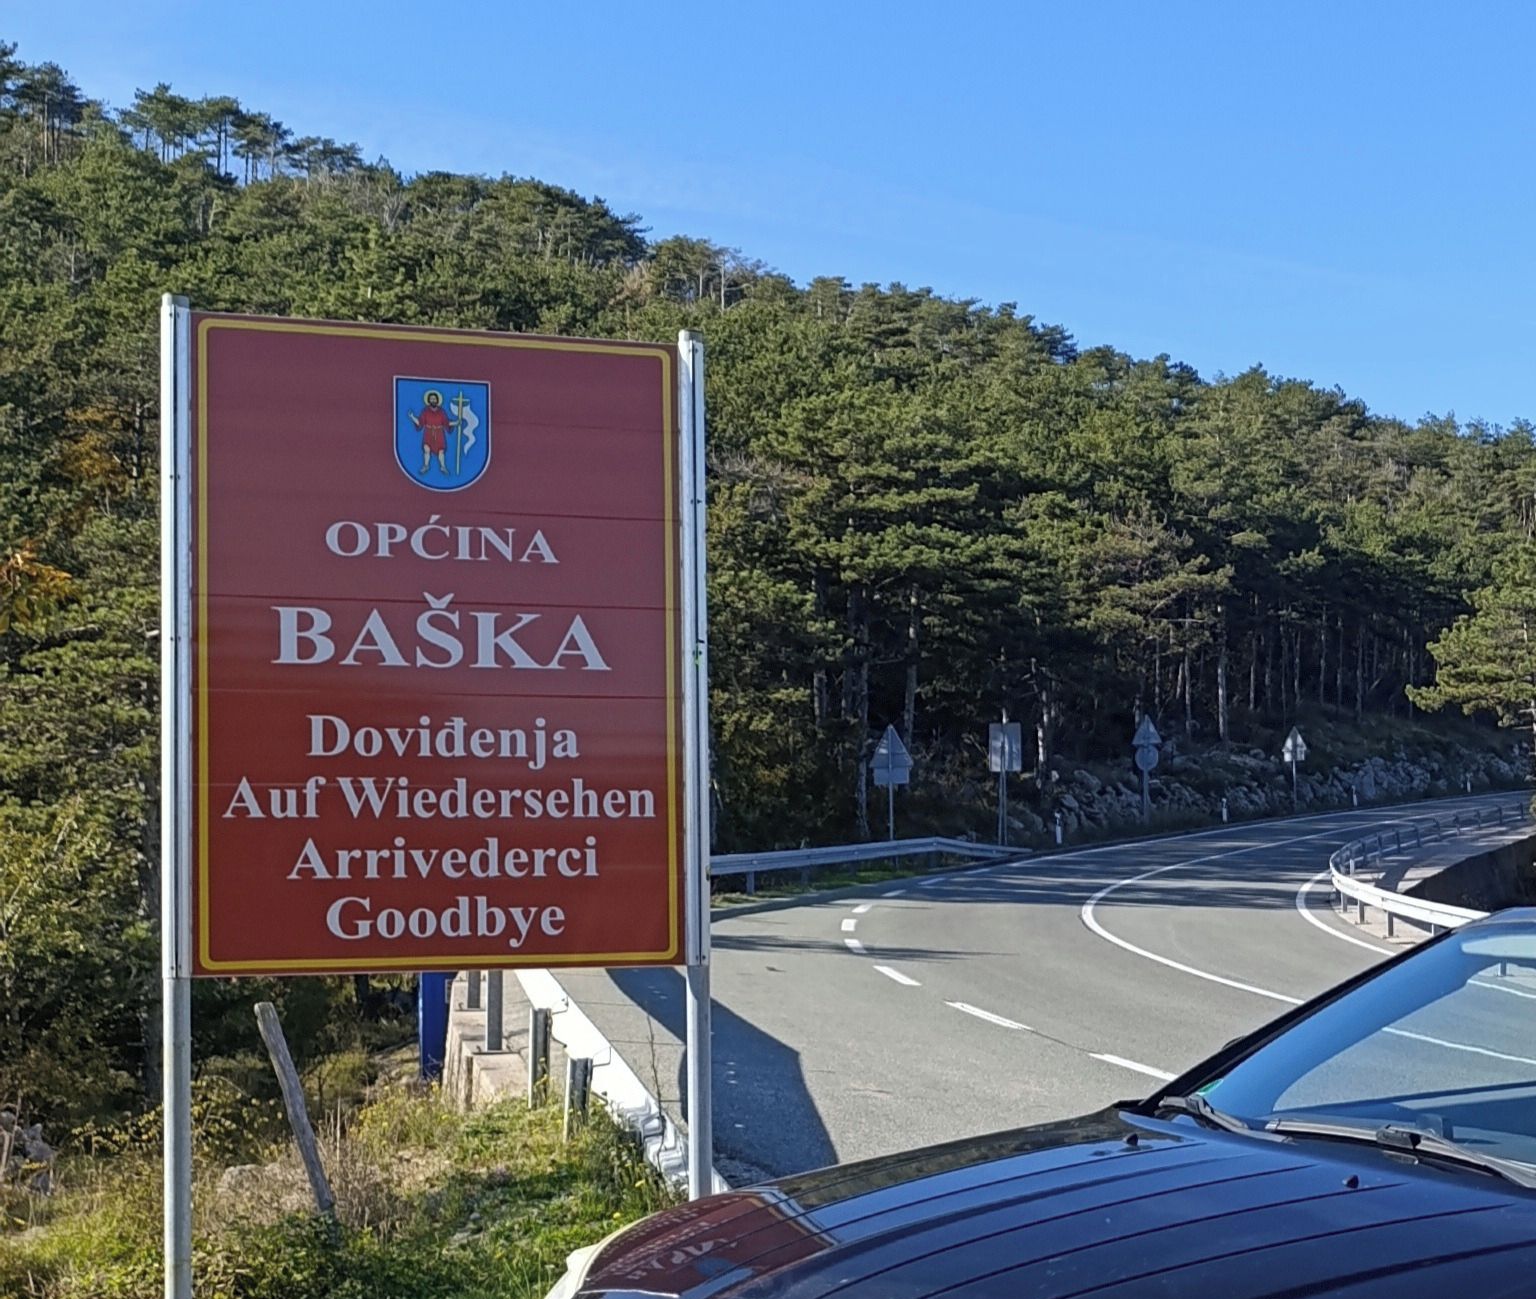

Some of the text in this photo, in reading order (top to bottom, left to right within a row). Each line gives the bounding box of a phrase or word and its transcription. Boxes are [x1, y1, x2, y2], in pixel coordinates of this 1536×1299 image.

[325, 514, 559, 564] OPĆINA
[271, 591, 612, 671] BAŠKA
[307, 714, 580, 770] Doviđenja
[223, 776, 656, 819] Auf Wiedersehen
[287, 836, 600, 880] Arrivederci
[326, 896, 566, 948] Goodbye
